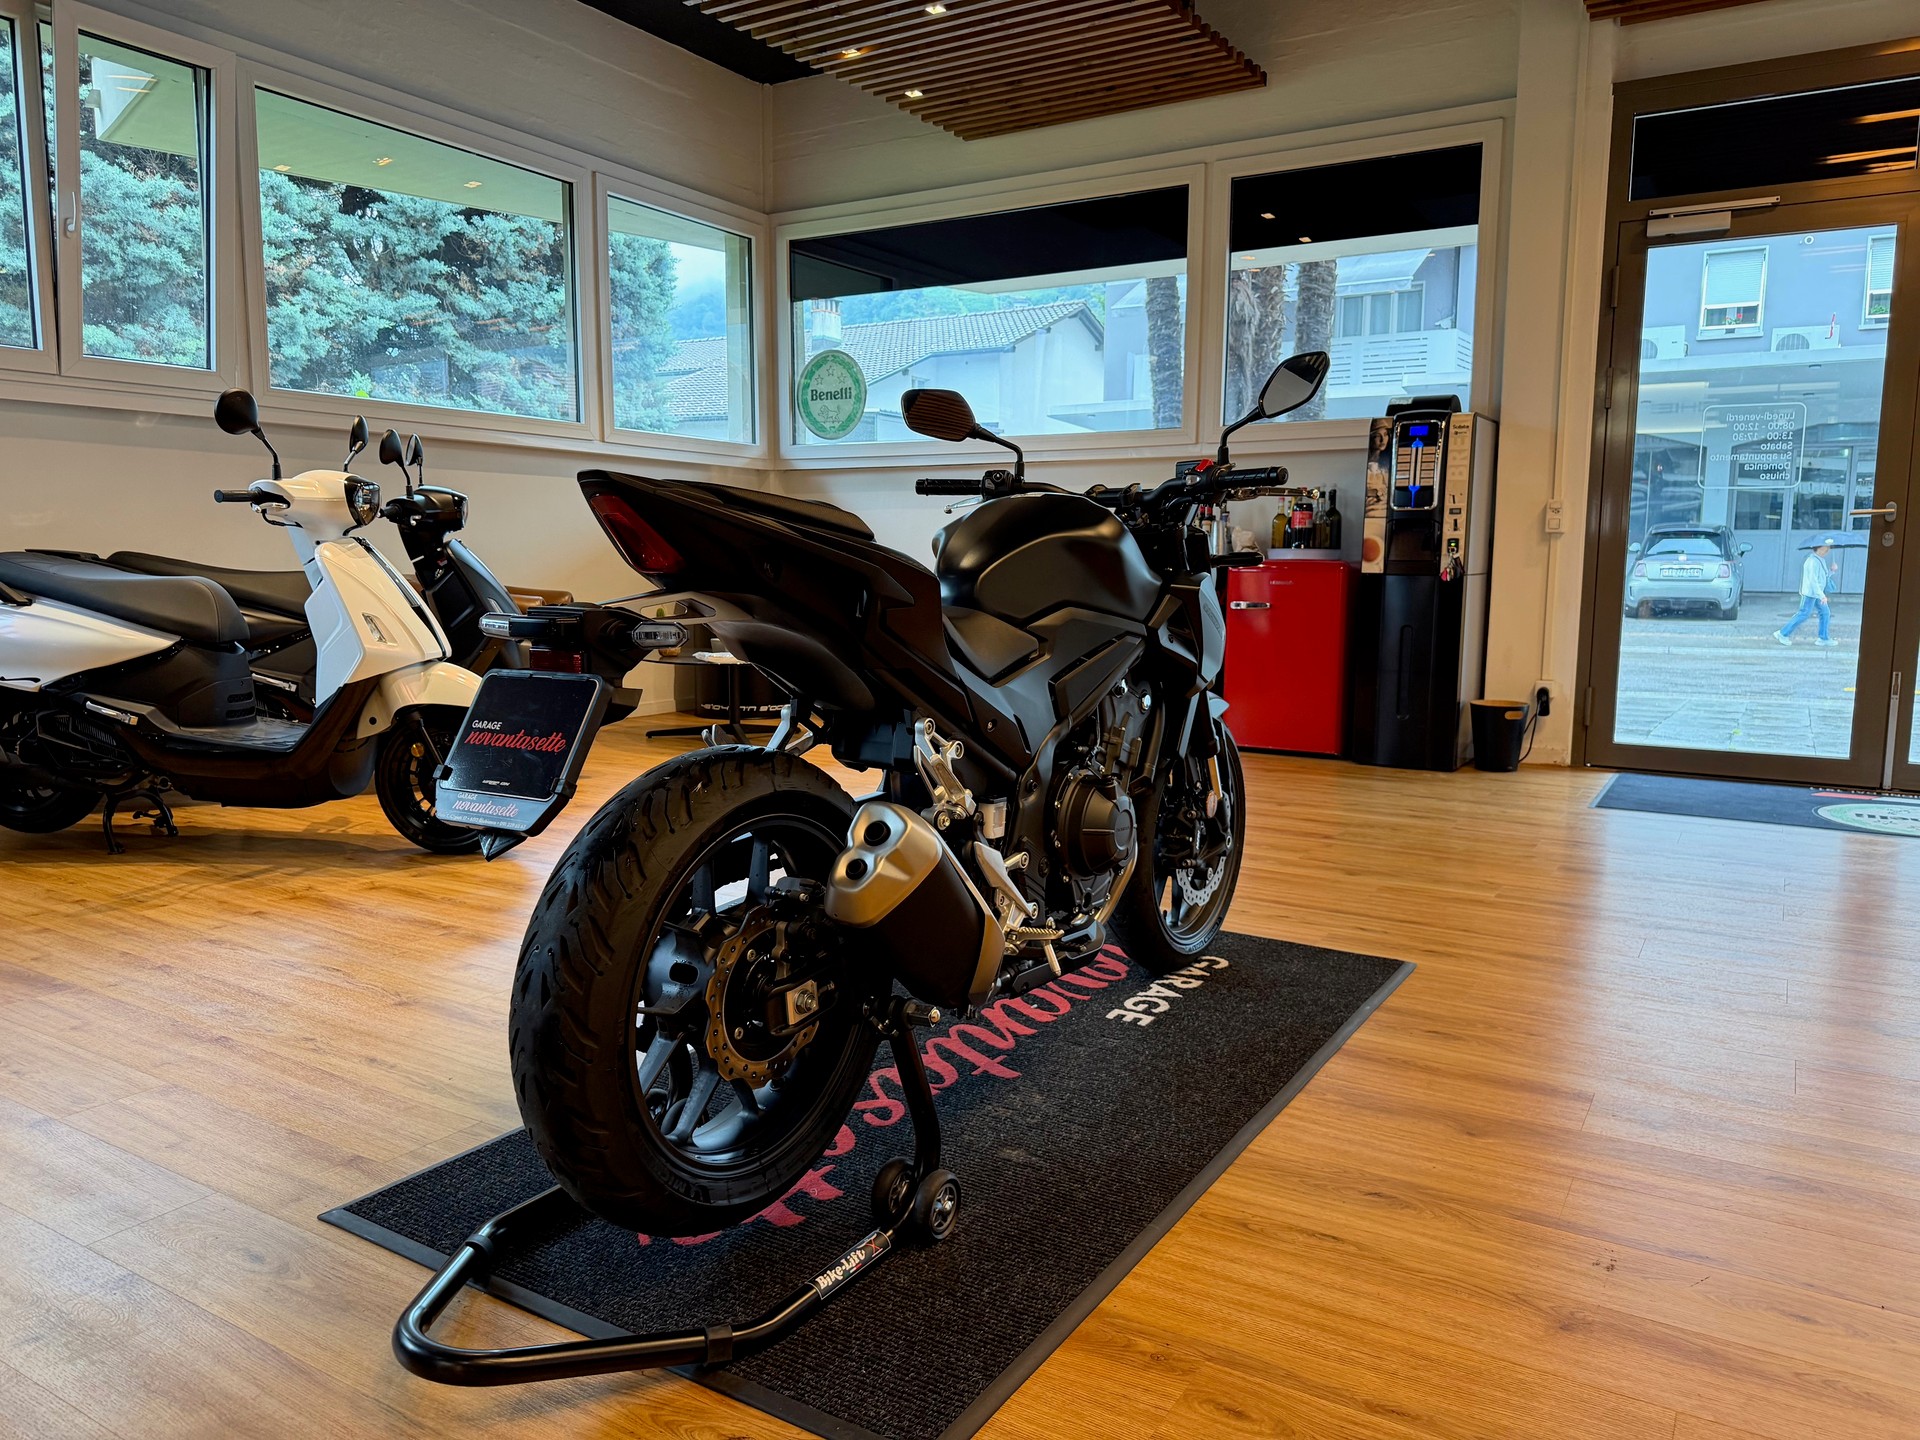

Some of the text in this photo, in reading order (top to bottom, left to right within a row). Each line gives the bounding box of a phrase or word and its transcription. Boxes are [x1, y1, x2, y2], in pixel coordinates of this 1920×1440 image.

[810, 387, 852, 401] Benelli
[471, 720, 502, 730] GARAGE
[464, 729, 566, 752] novantasette
[457, 792, 478, 800] GARAGE
[452, 800, 519, 817] novantasette
[1105, 955, 1229, 1026] GARAGE
